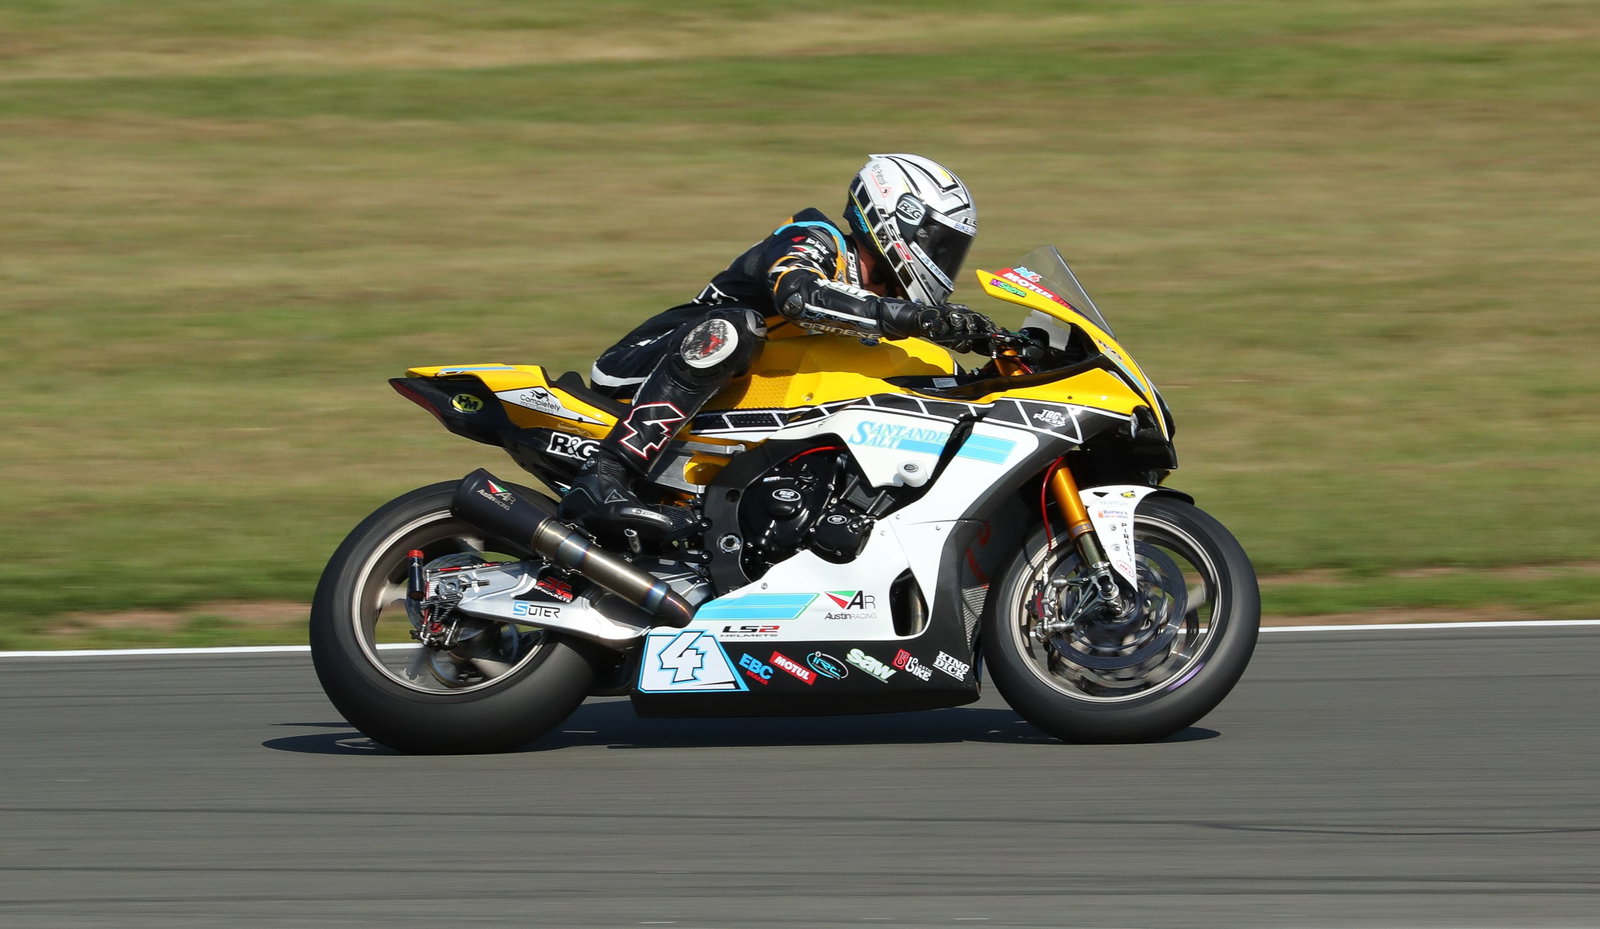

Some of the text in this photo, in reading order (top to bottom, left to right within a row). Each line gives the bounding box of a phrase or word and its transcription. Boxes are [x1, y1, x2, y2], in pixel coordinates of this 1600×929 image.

[898, 202, 923, 220] R&G
[847, 252, 861, 289] DAIN
[1002, 272, 1055, 299] MOTUL
[799, 321, 879, 342] DAINESE
[519, 393, 561, 412] Completely
[618, 402, 688, 461] 4
[848, 420, 953, 447] SANTANDE
[546, 432, 600, 461] R&G
[1121, 522, 1133, 563] PIRELLI
[845, 590, 877, 610] AR
[722, 625, 781, 634] LS2
[657, 632, 709, 686] 4
[738, 652, 774, 681] EBC
[774, 655, 811, 681] MOTUL
[933, 659, 967, 680] DICK
[936, 650, 971, 673] KING
